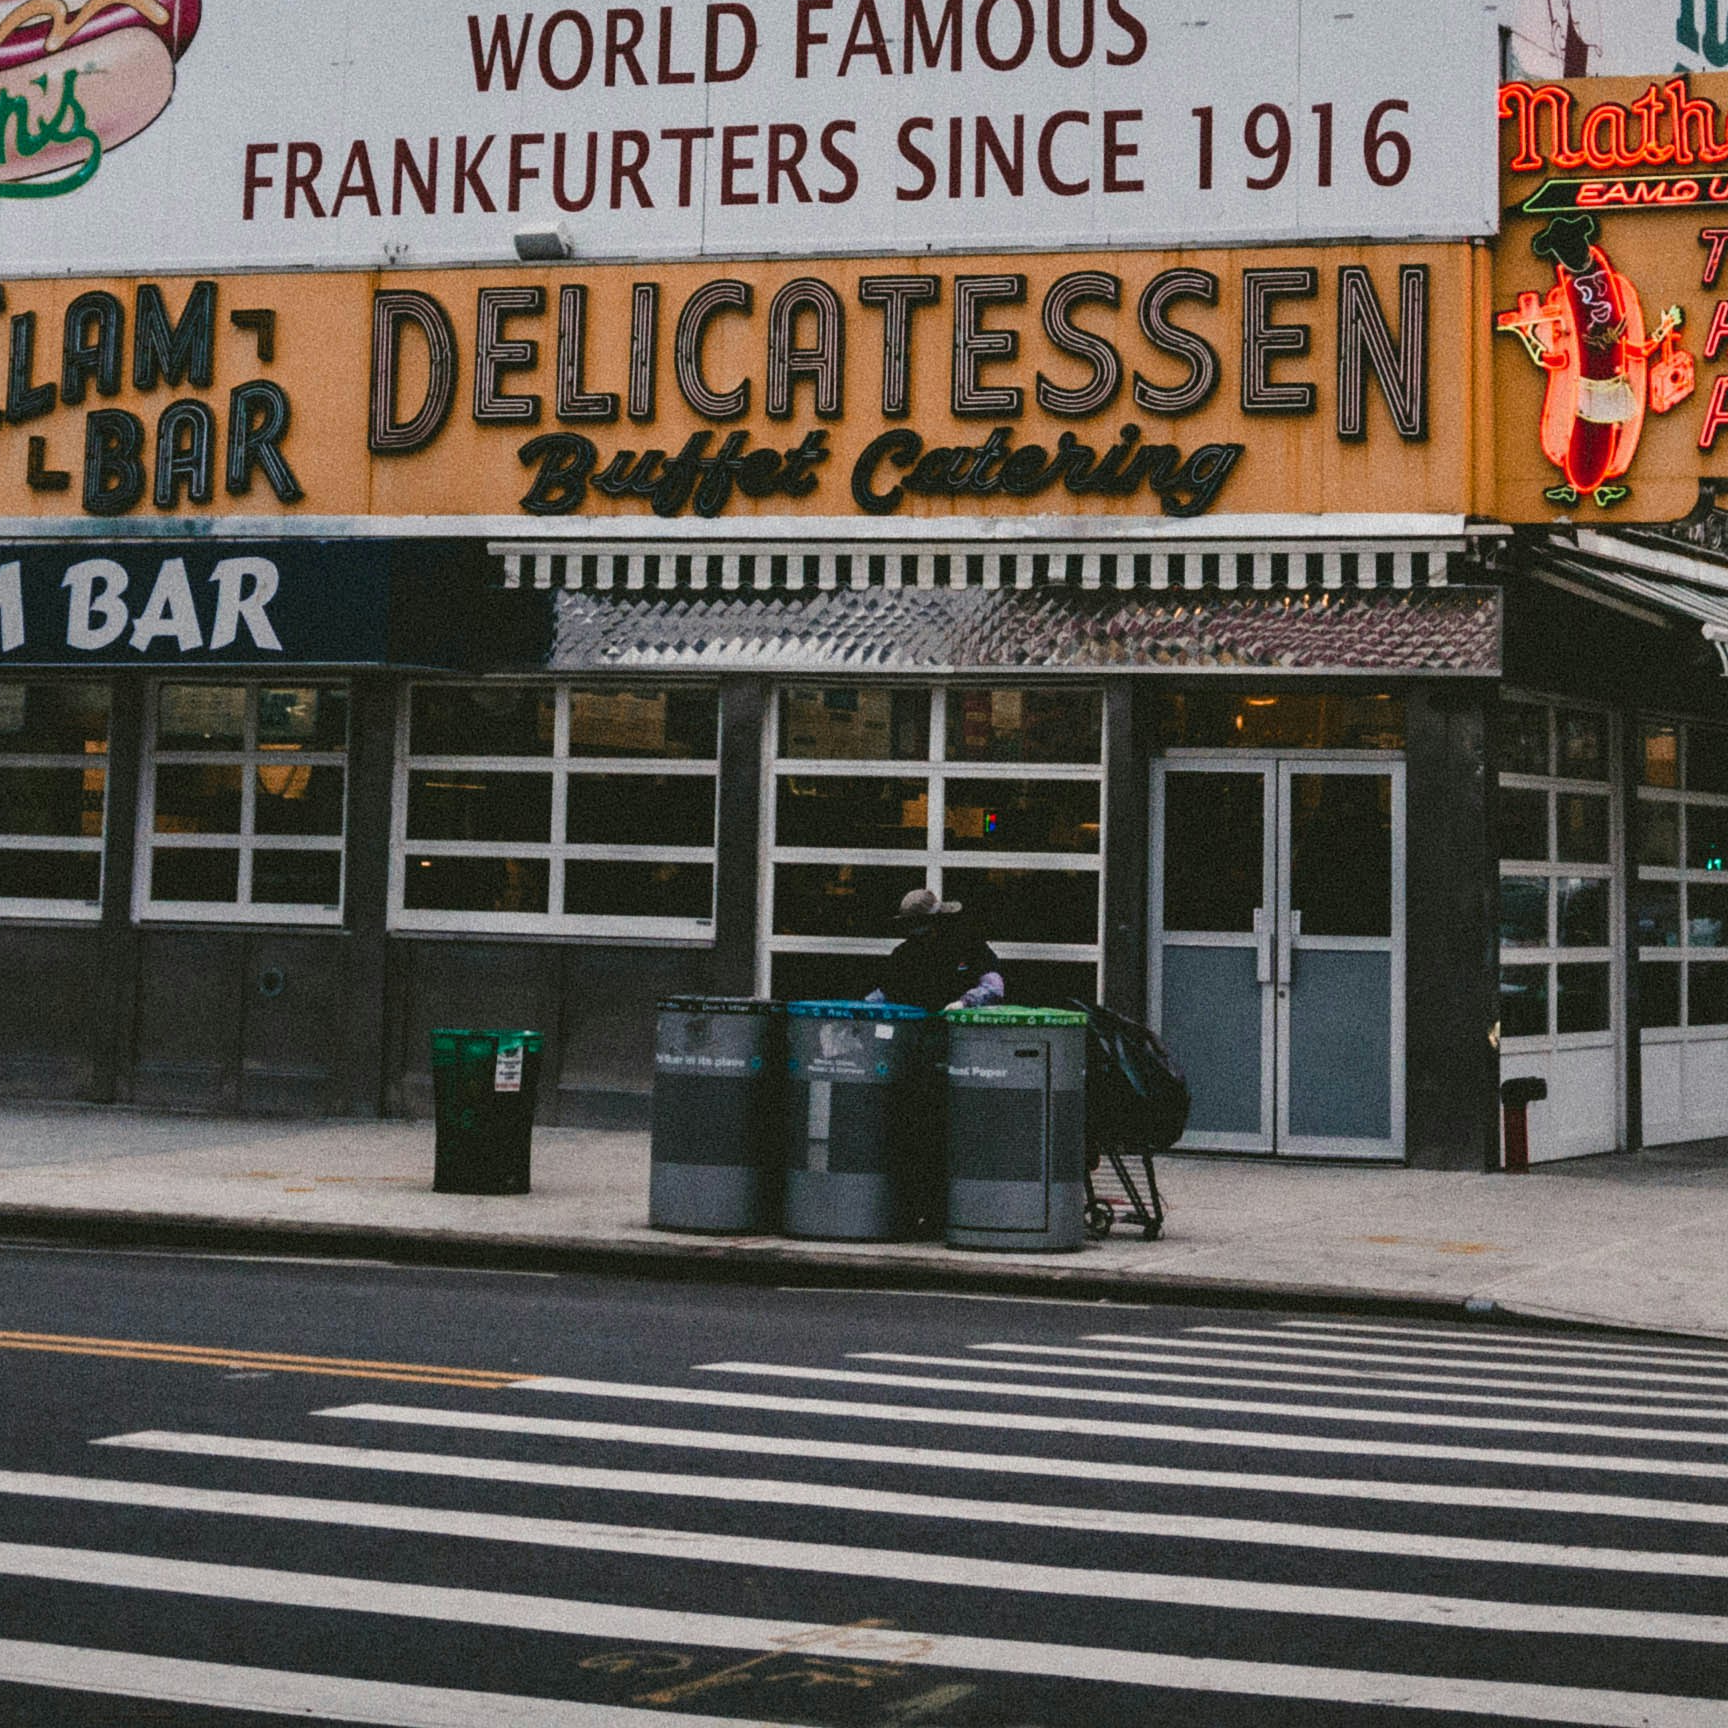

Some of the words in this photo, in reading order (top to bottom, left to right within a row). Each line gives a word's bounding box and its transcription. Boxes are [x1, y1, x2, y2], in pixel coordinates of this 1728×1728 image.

[465, 0, 760, 95] WORLD
[240, 117, 861, 221] FRANKFURTERS
[893, 107, 1146, 203] SINCE
[1196, 97, 1415, 191] 1916
[367, 262, 1432, 458] DELICATESSEN
[82, 378, 305, 517] BAR
[517, 428, 832, 519] Buffet
[849, 422, 1248, 520] Catering
[60, 555, 283, 654] BAR
